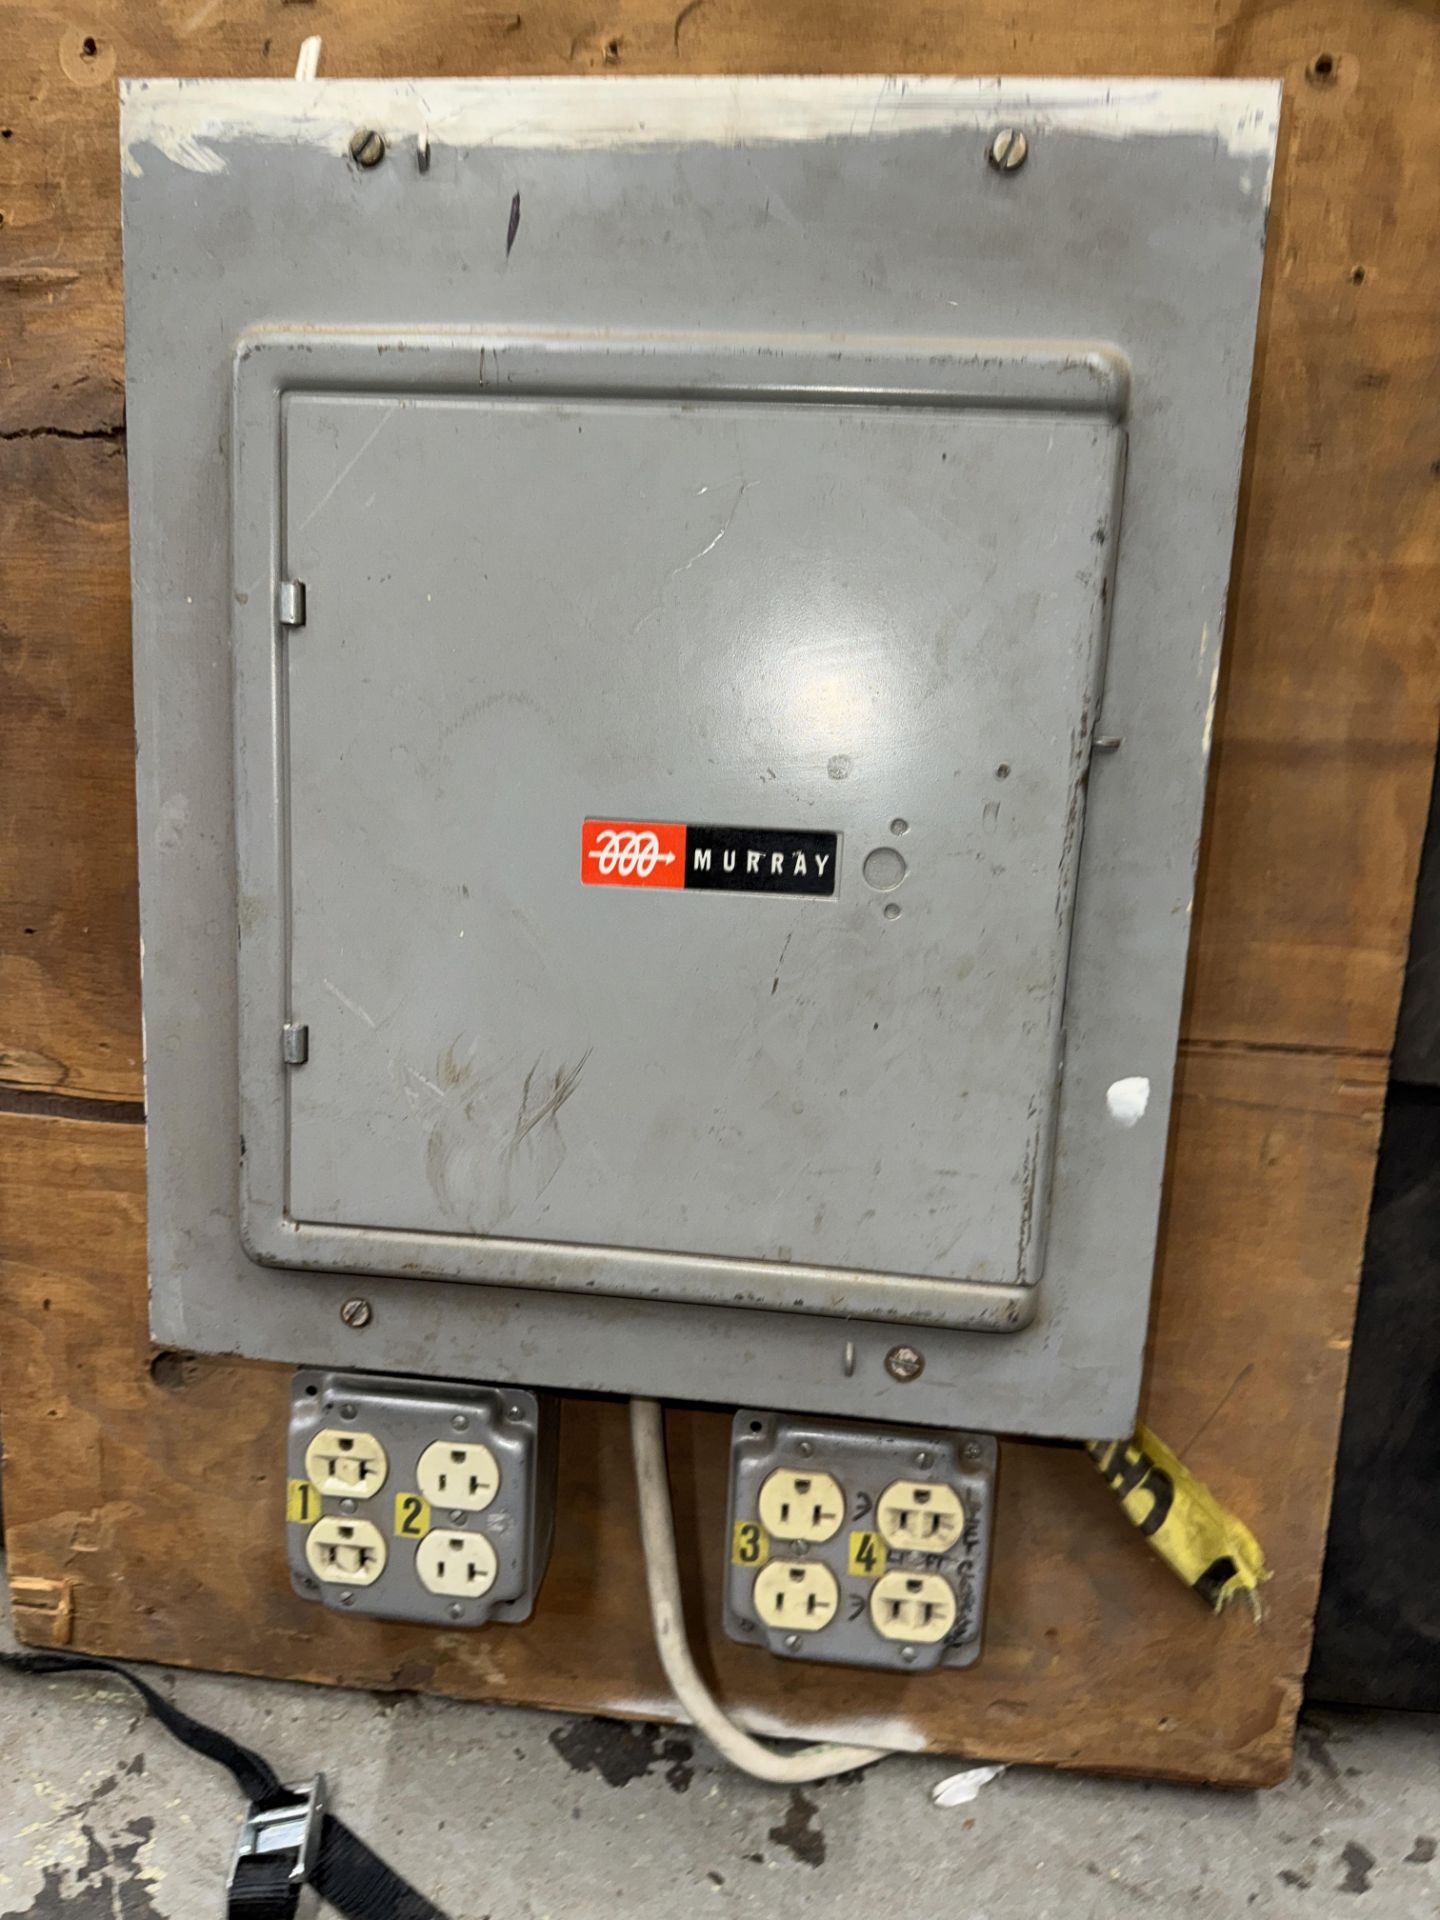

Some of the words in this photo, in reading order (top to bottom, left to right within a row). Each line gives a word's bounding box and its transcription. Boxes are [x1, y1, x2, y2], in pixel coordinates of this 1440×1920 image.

[693, 848, 830, 876] MURRAY
[297, 1483, 309, 1520] 1
[401, 1497, 422, 1535] 2
[739, 1524, 761, 1563] 3
[855, 1534, 878, 1572] 4
